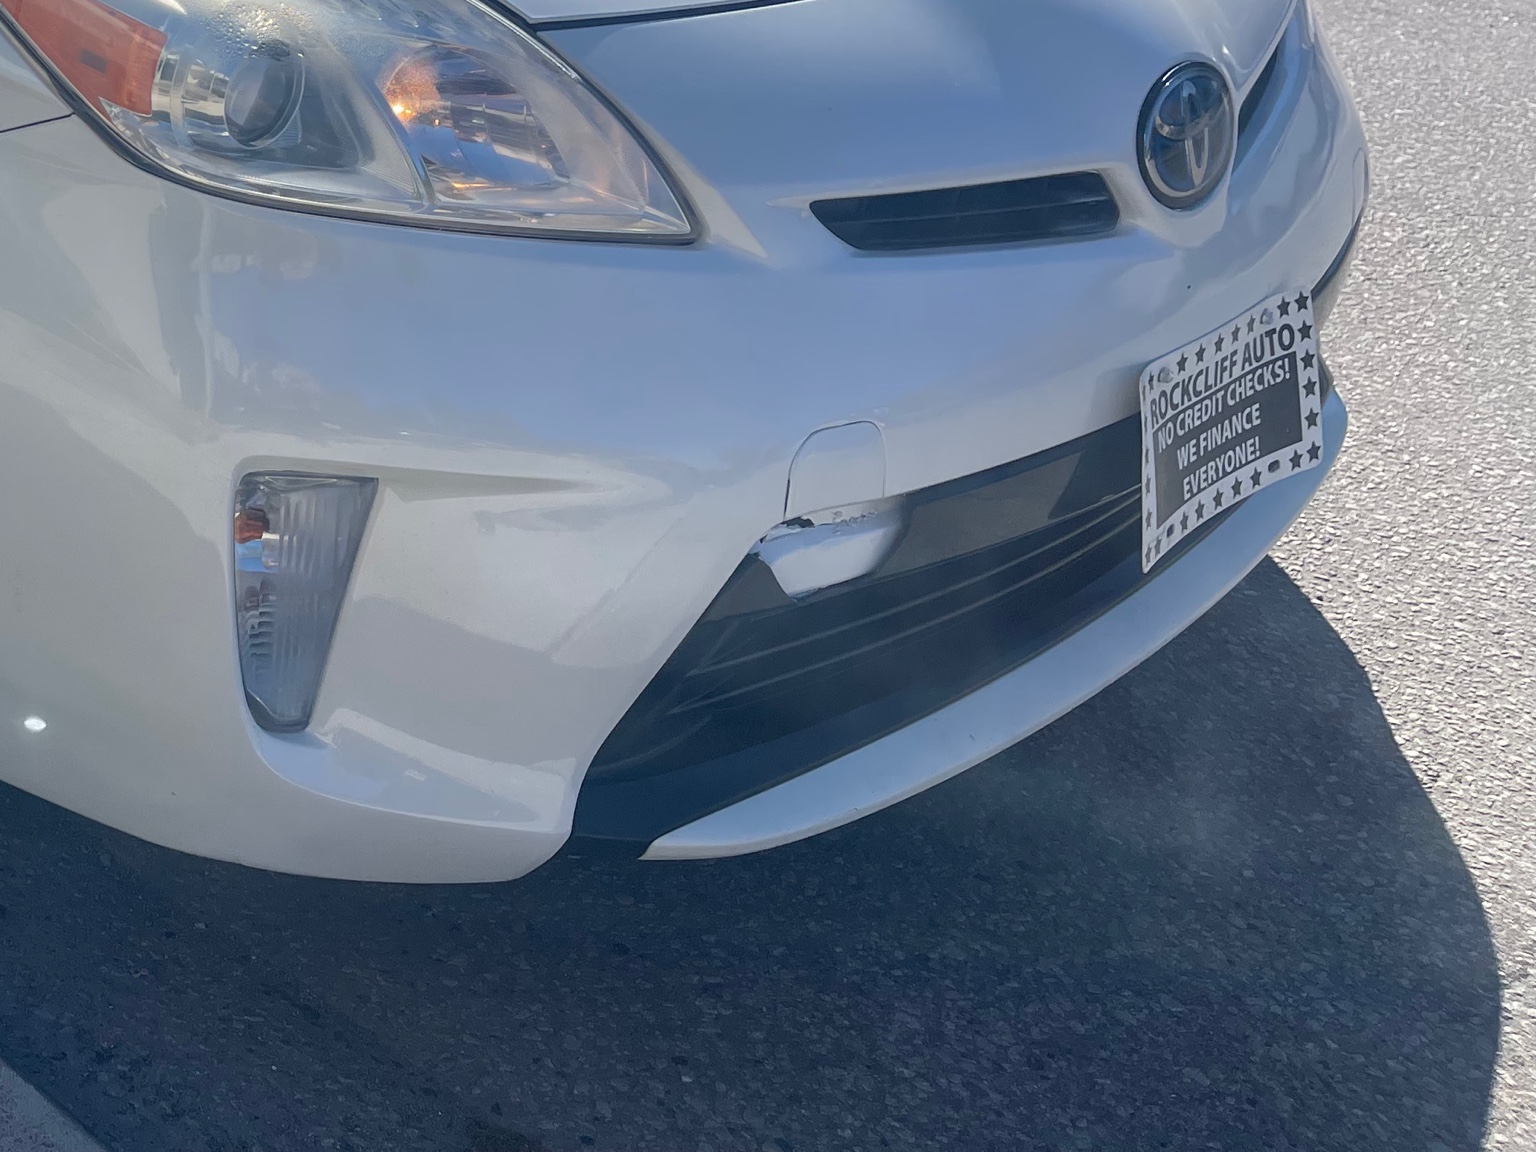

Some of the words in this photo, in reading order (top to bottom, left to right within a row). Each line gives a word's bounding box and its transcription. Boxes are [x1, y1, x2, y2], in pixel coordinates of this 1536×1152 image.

[1149, 348, 1240, 430] ROCKCLIFF
[1240, 322, 1296, 372] AUTO
[1156, 424, 1175, 454] NO
[1175, 393, 1226, 437] CREDIT
[1226, 357, 1291, 408] CHECKS!
[1176, 437, 1198, 471] WE
[1199, 402, 1262, 456] FINANCE
[1182, 435, 1261, 501] EVERYONE!
